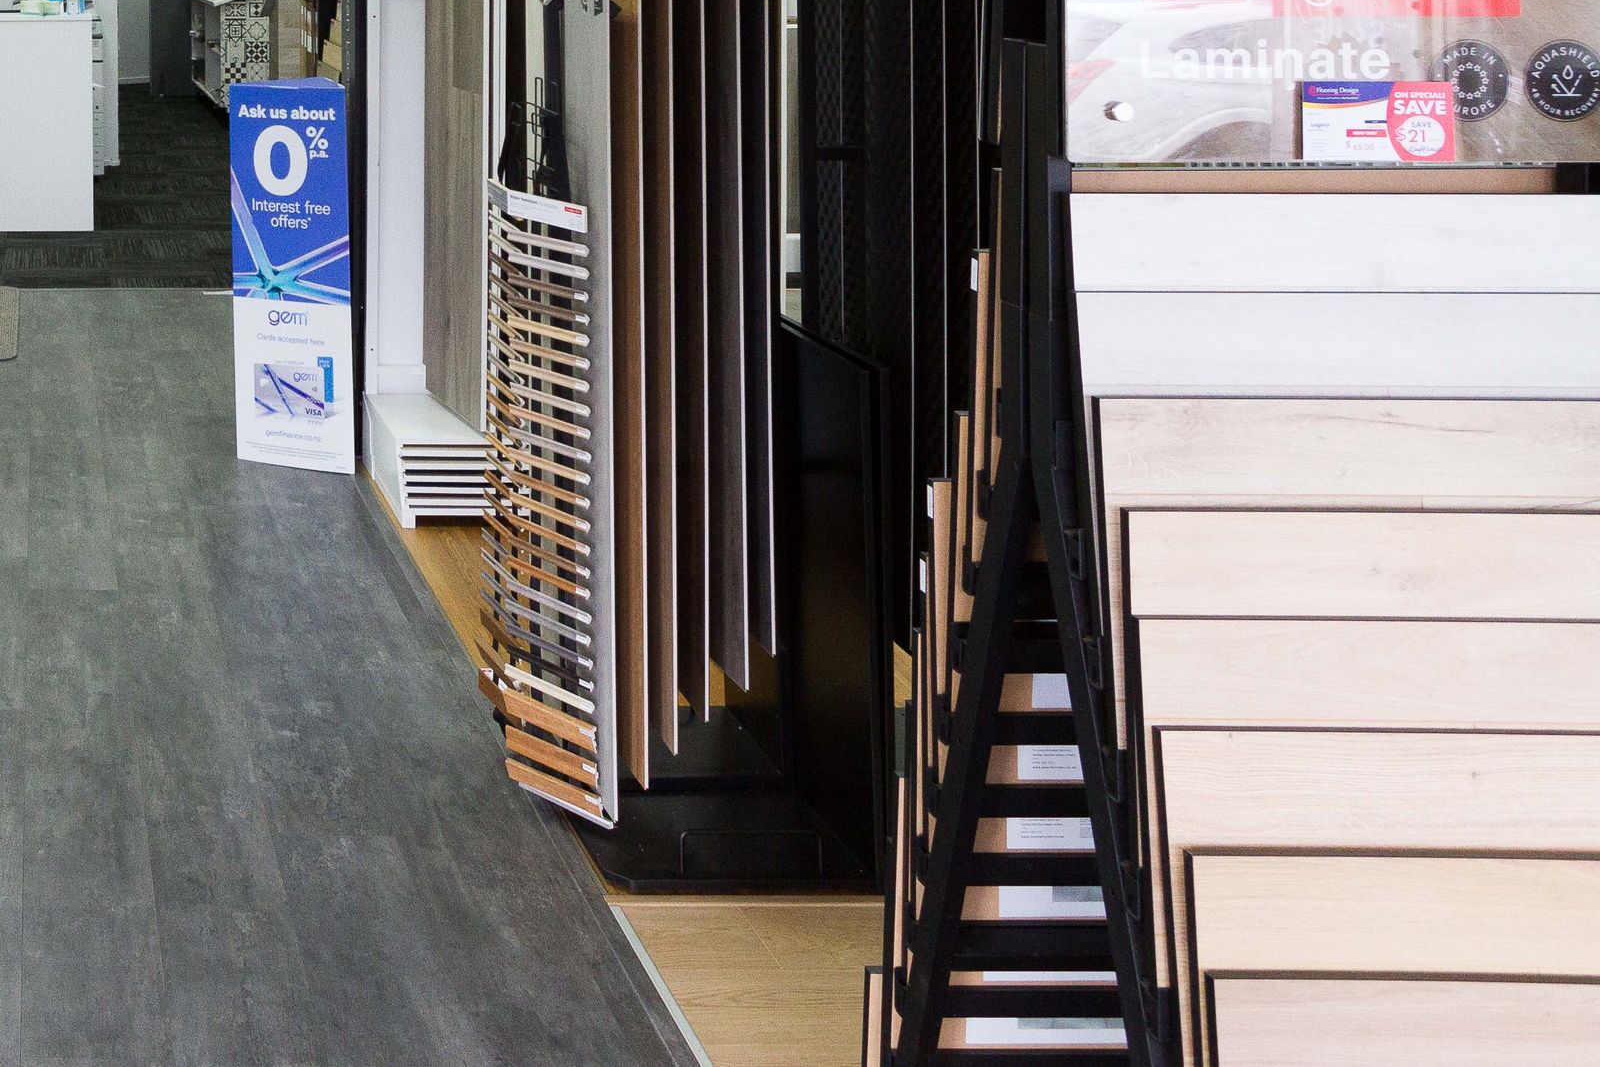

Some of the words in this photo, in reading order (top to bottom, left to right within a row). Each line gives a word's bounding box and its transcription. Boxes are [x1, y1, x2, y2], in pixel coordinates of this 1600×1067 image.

[1140, 39, 1391, 80] Laminate
[1442, 46, 1477, 66] MADE
[1482, 51, 1498, 66] IN
[1531, 46, 1600, 79] AQUASHIELD
[1316, 86, 1338, 95] Flooring
[1339, 86, 1360, 95] Design
[1394, 91, 1408, 99] ON
[1394, 100, 1447, 115] SAVE
[1452, 99, 1496, 116] UROPE
[1539, 99, 1562, 116] HOUR
[1564, 87, 1600, 117] RECOVERY
[238, 104, 267, 119] Ask
[269, 108, 288, 120] us
[290, 105, 337, 121] about
[1395, 127, 1407, 142] $
[1408, 129, 1427, 143] 21
[309, 150, 329, 160] p.a.
[251, 198, 302, 214] Interest
[304, 200, 332, 216] free
[268, 309, 308, 326] gem
[256, 332, 277, 342] Cards
[278, 336, 308, 346] accepted
[309, 338, 325, 347] here
[292, 371, 319, 382] gem
[305, 407, 323, 417] VISA
